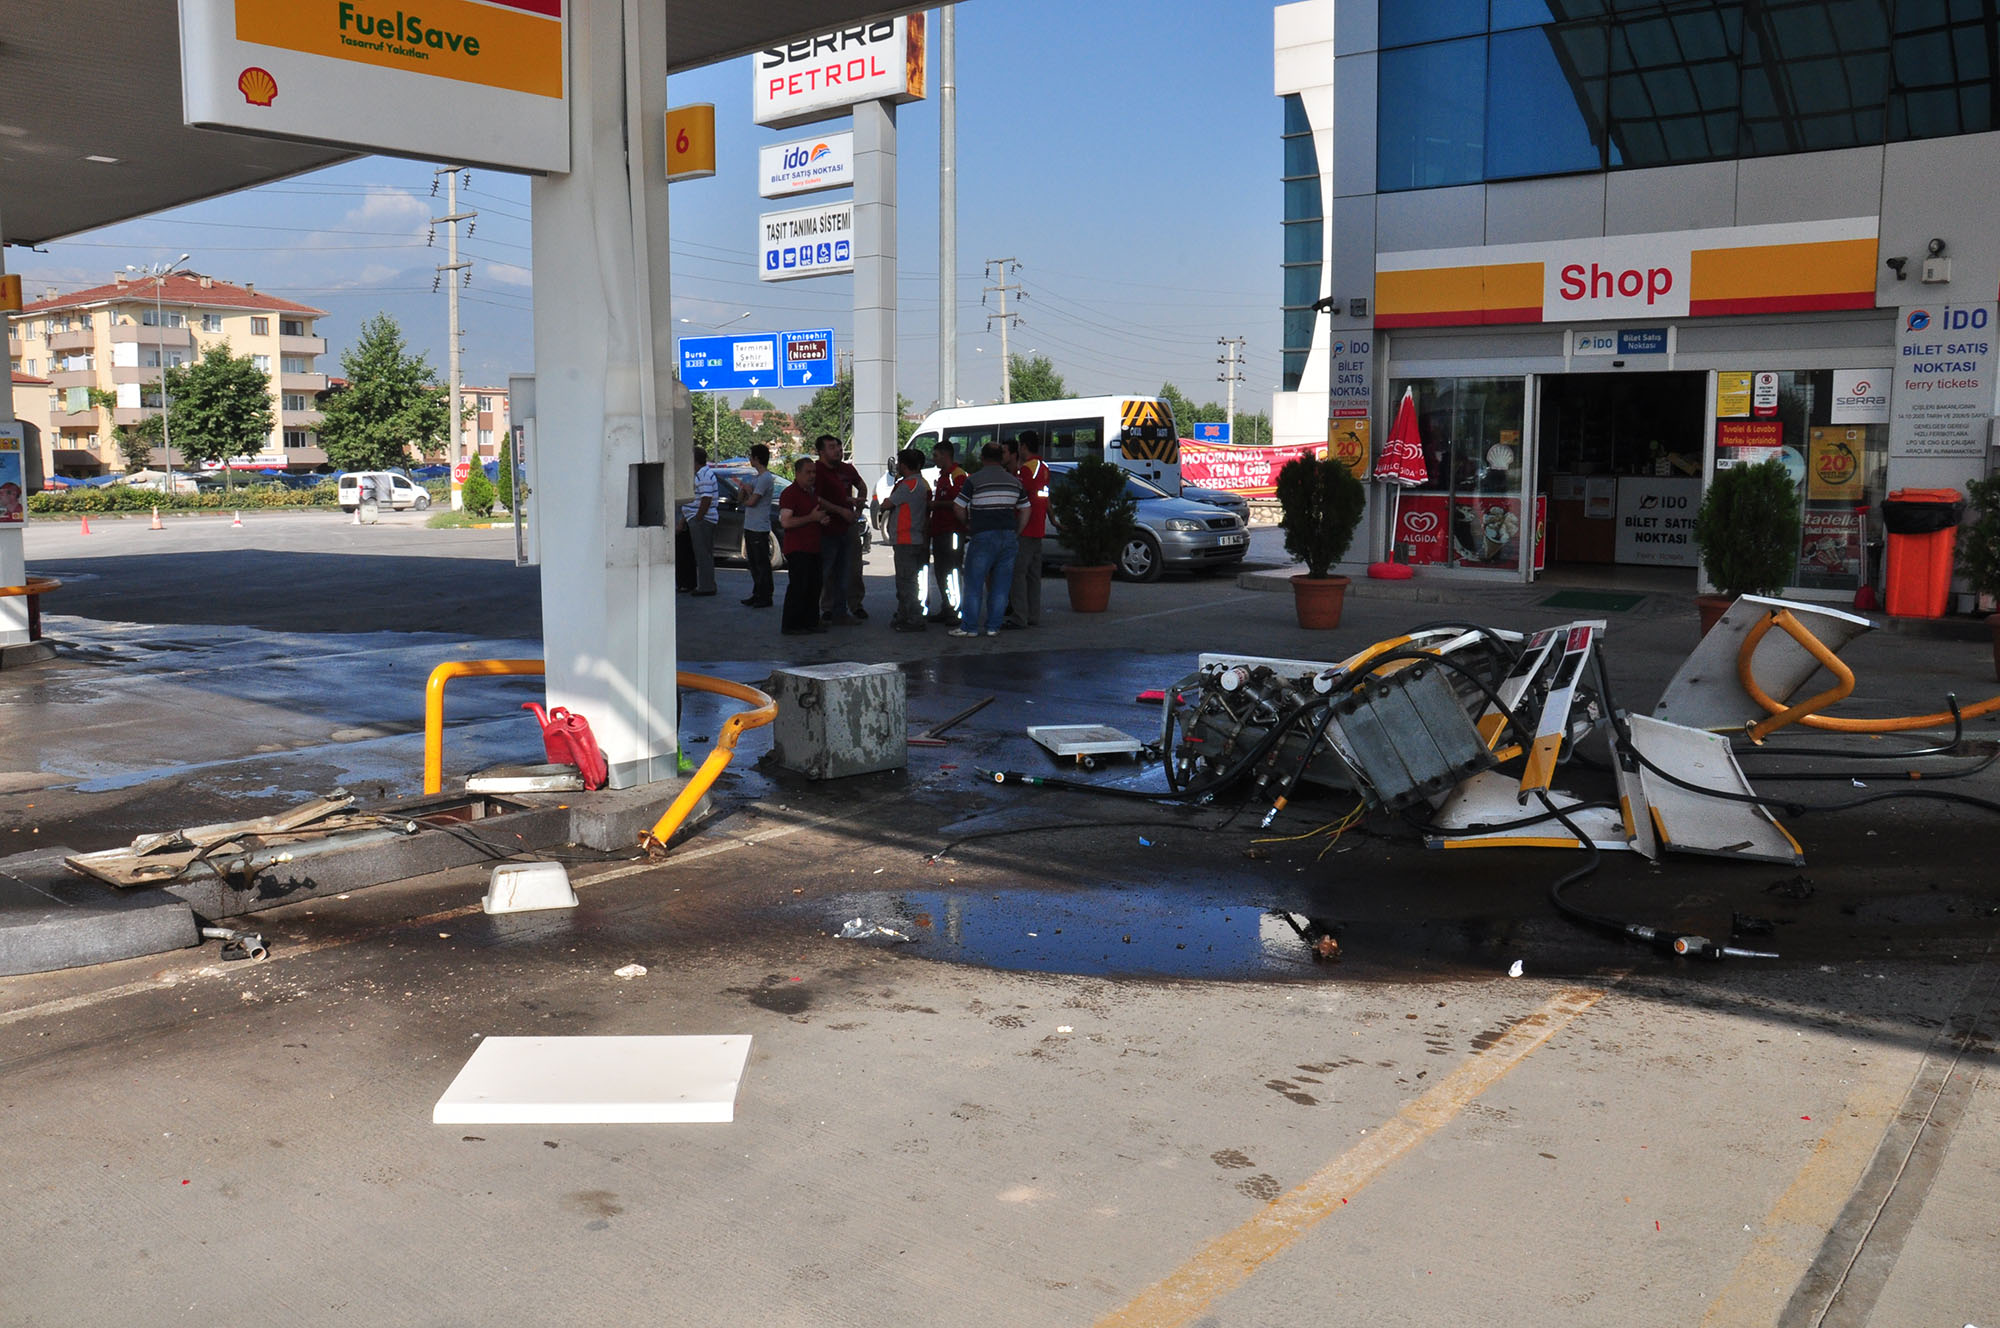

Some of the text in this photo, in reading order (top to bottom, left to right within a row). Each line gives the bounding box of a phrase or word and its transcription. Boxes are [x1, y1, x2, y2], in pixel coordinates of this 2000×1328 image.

[339, 1, 480, 56] FuelSave
[340, 34, 384, 51] Tasarruf
[770, 56, 886, 100] PETROL
[676, 128, 689, 154] 6
[783, 146, 809, 170] ido
[771, 164, 844, 183] BİLET SATIŞ NOKTASI
[767, 208, 850, 245] TAŞIT TANIMA SİSTEMİ
[1560, 263, 1673, 305] Shop
[1944, 306, 1988, 330] İDO
[786, 332, 827, 341] Yenişehir
[1623, 334, 1641, 342] Bilet
[796, 342, 817, 351] İznik
[1350, 339, 1370, 354] İDO
[1903, 343, 1988, 356] BİLET SATIŞ
[685, 351, 707, 359] Bursa
[789, 349, 825, 359] (Nicaea)
[735, 361, 767, 369] Merkezi
[1338, 360, 1364, 371] BİLET
[1913, 361, 1976, 373] NOKTASI
[1338, 374, 1364, 386] SATIŞ
[1905, 379, 1979, 392] ferry tickets
[1331, 387, 1370, 397] NOKTASI
[1746, 425, 1752, 433] &
[1753, 425, 1777, 433] Lavabo
[1182, 450, 1263, 465] MOTORUNUZU
[1625, 515, 1658, 528] BİLET
[1635, 532, 1687, 544] NOKTASI
